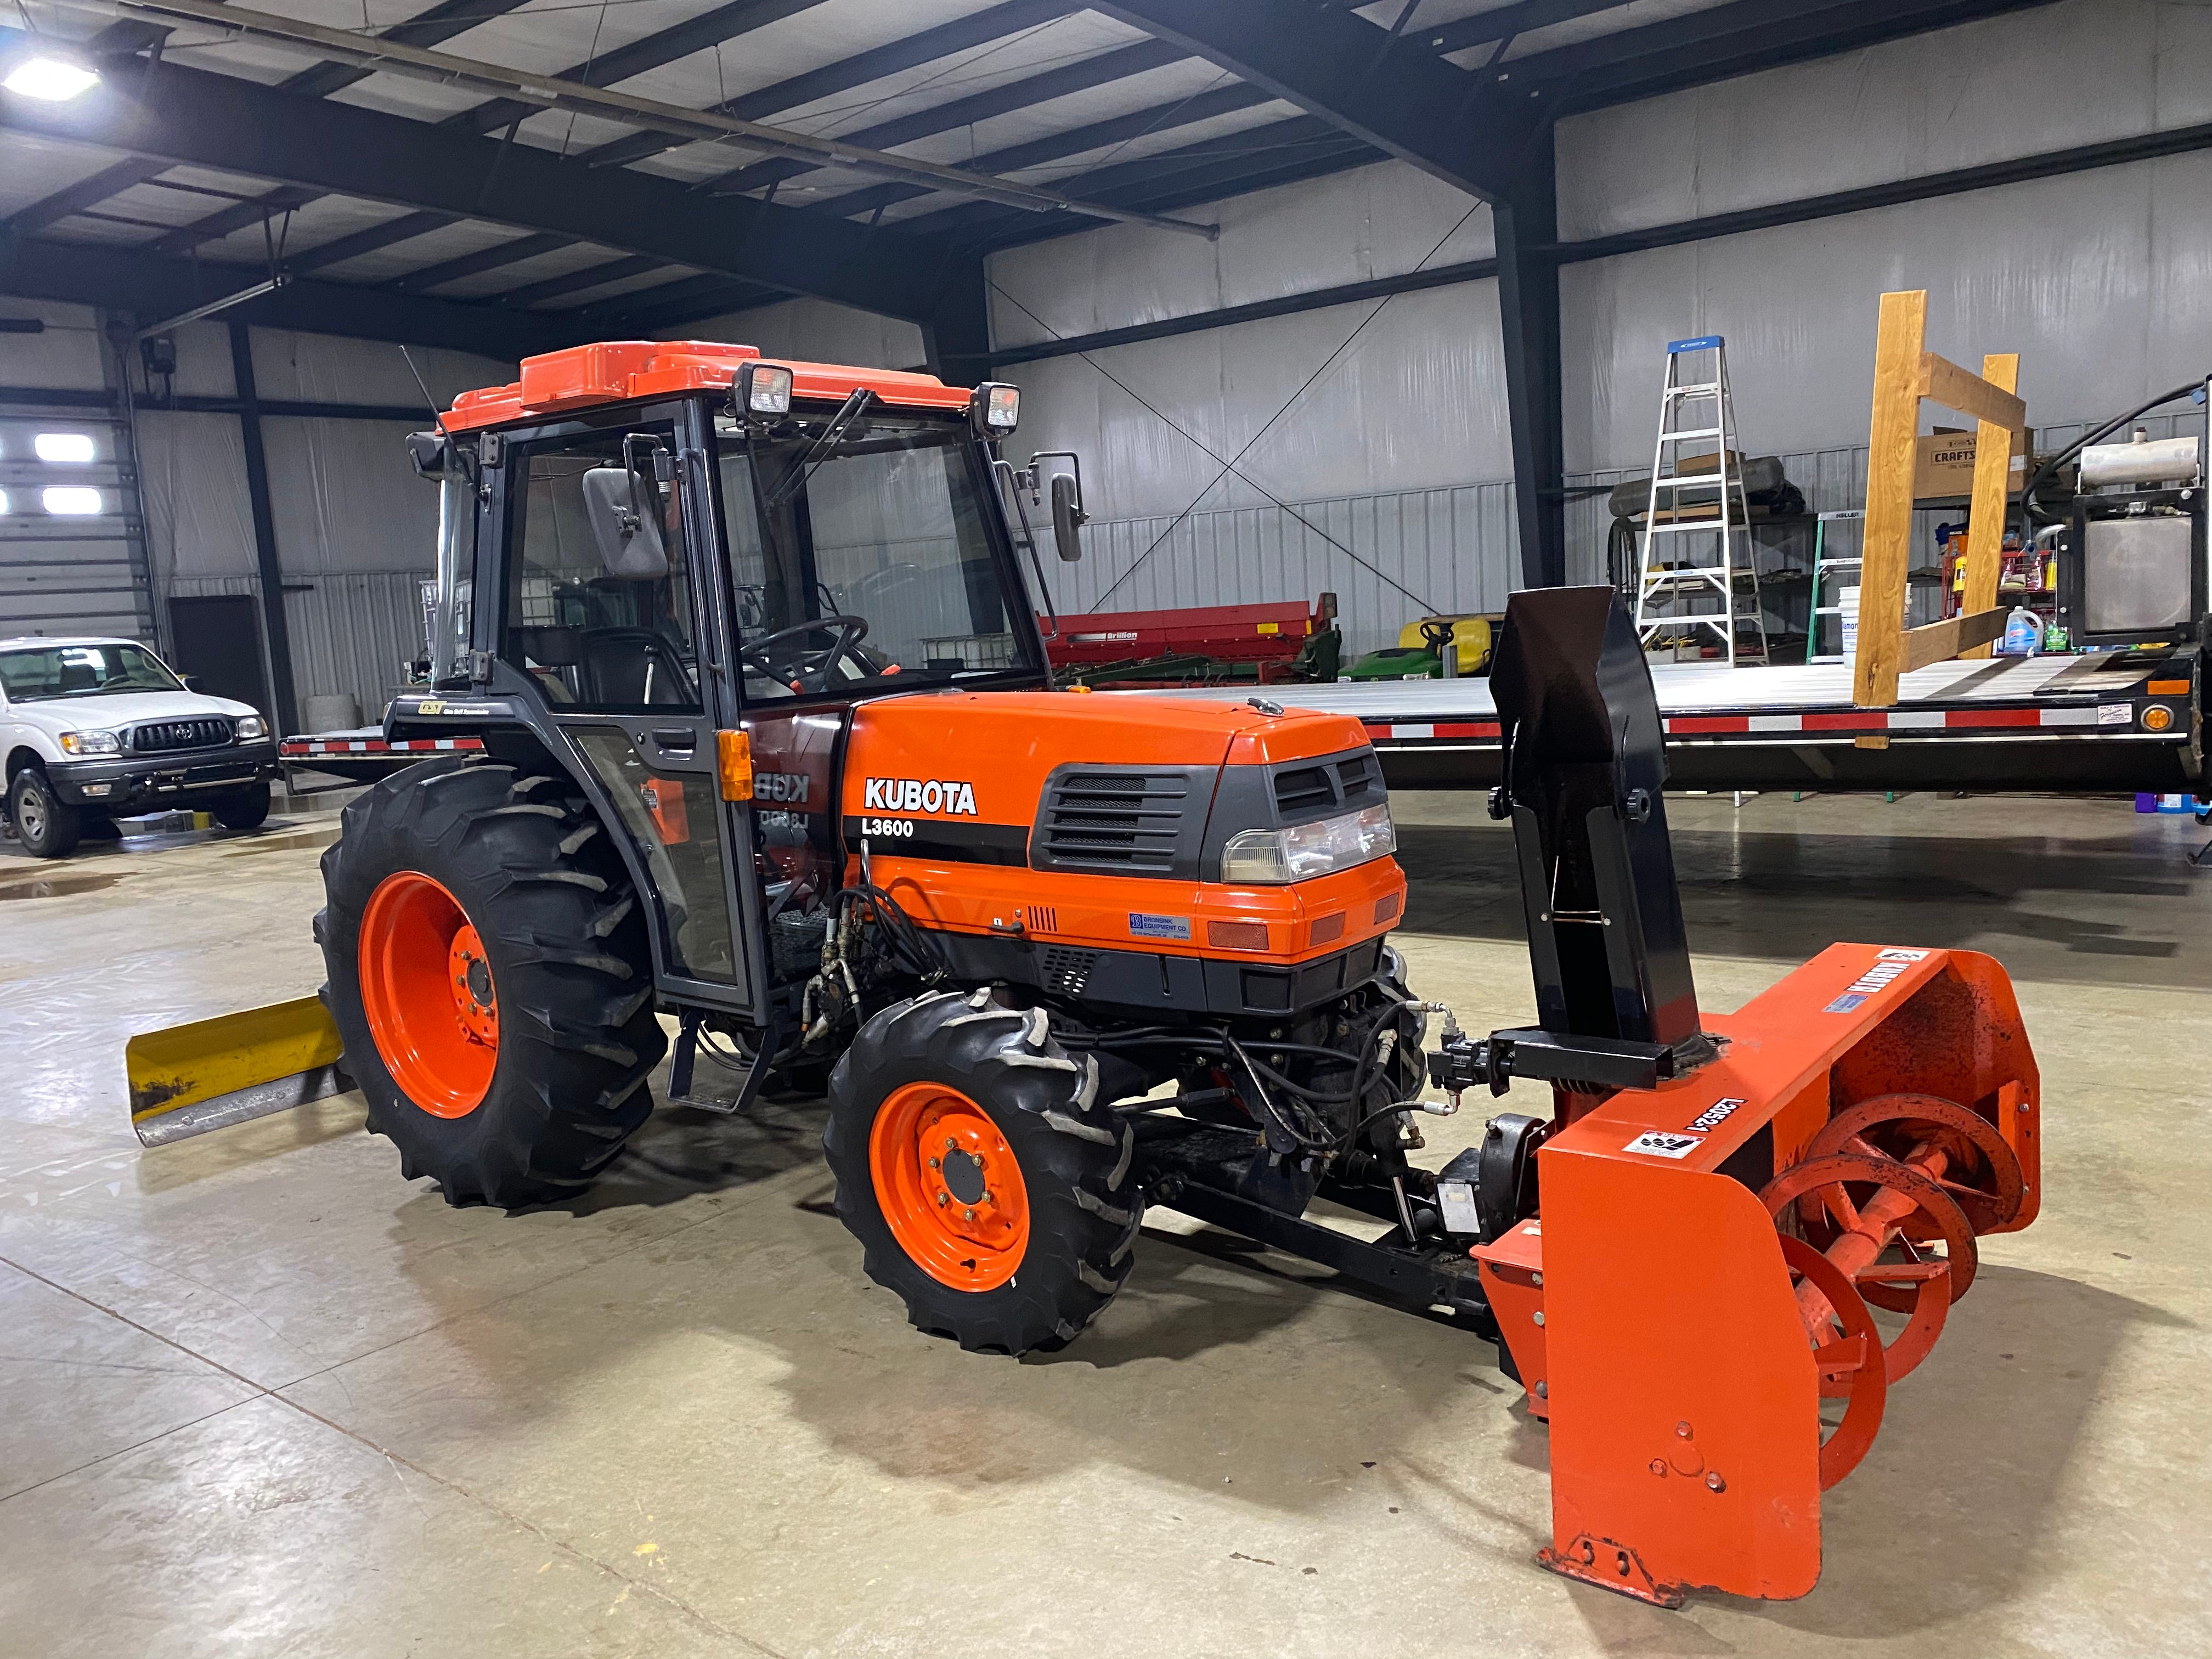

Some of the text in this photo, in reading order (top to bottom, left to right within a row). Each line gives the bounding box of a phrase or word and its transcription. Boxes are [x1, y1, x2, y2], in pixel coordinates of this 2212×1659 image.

[1935, 451, 1976, 462] CRAFTS
[418, 701, 448, 714] GST
[865, 778, 978, 816] KUBOTA
[862, 817, 913, 837] L3600
[1844, 962, 1911, 993] KUBOTA
[1685, 1097, 1747, 1132] L2052-1
